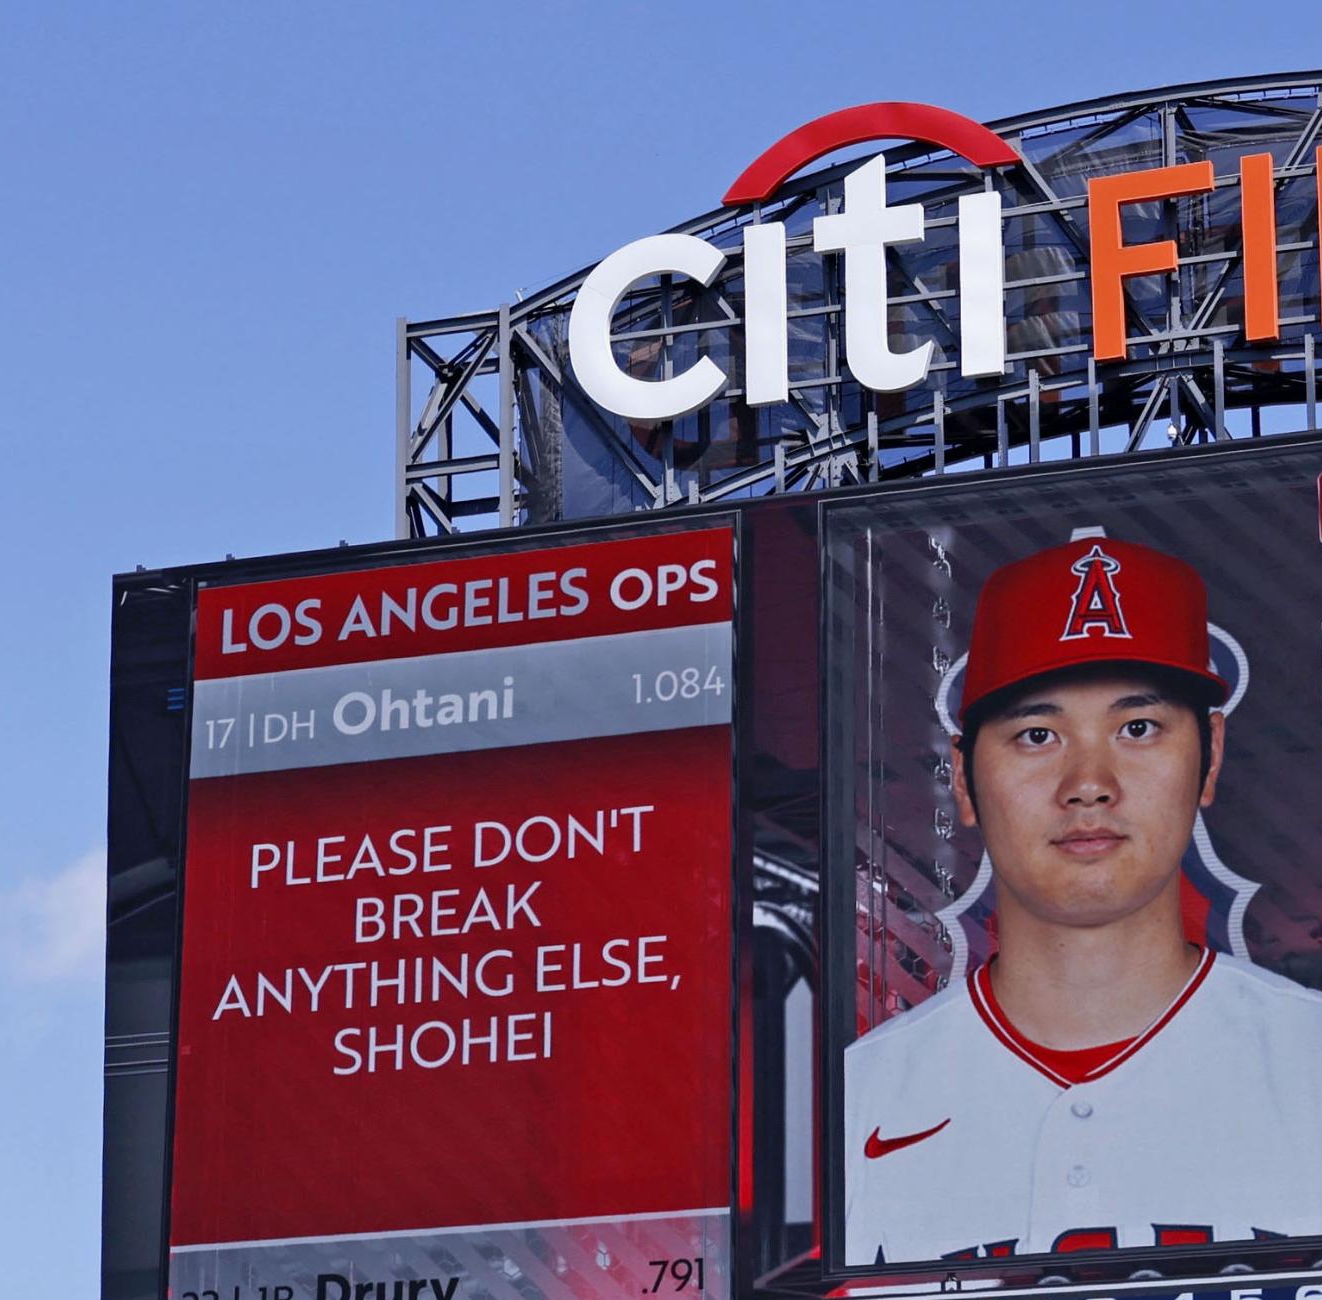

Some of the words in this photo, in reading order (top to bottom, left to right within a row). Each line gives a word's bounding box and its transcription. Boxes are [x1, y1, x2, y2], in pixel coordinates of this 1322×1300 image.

[568, 154, 1005, 423] citi
[221, 598, 322, 654] LOS
[338, 567, 590, 641] ANGELES
[609, 559, 718, 612] OPS
[332, 676, 515, 736] Ohtani
[631, 666, 725, 705] 1.084
[252, 825, 452, 888] PLEASE
[474, 805, 654, 868] DON'T
[354, 881, 542, 943] BREAK
[212, 948, 513, 1020] ANYTHING
[537, 935, 682, 992] ELSE,
[332, 1012, 553, 1076] SHOHEI
[641, 1258, 706, 1295] .791
